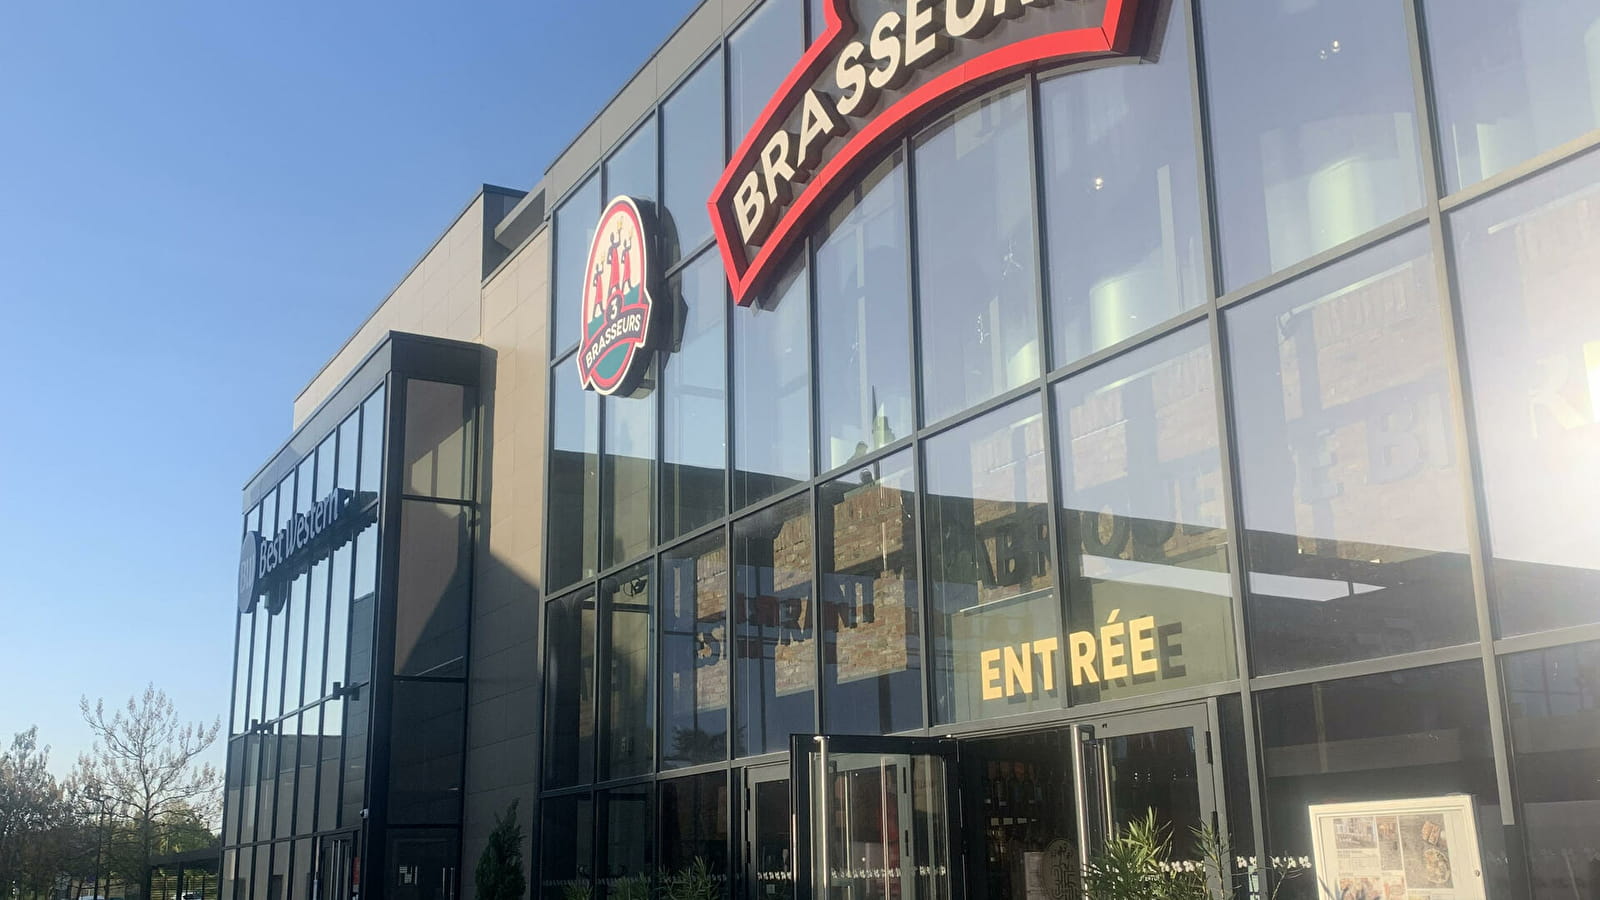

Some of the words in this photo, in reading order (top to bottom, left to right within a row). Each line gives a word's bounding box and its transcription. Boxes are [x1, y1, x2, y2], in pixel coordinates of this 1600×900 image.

[733, 0, 1035, 245] BRASSEU
[585, 313, 641, 369] BRASSEURS
[609, 298, 618, 320] 3
[258, 530, 283, 580] Best
[285, 488, 339, 560] Western
[980, 608, 1158, 701] ENTRÉE
